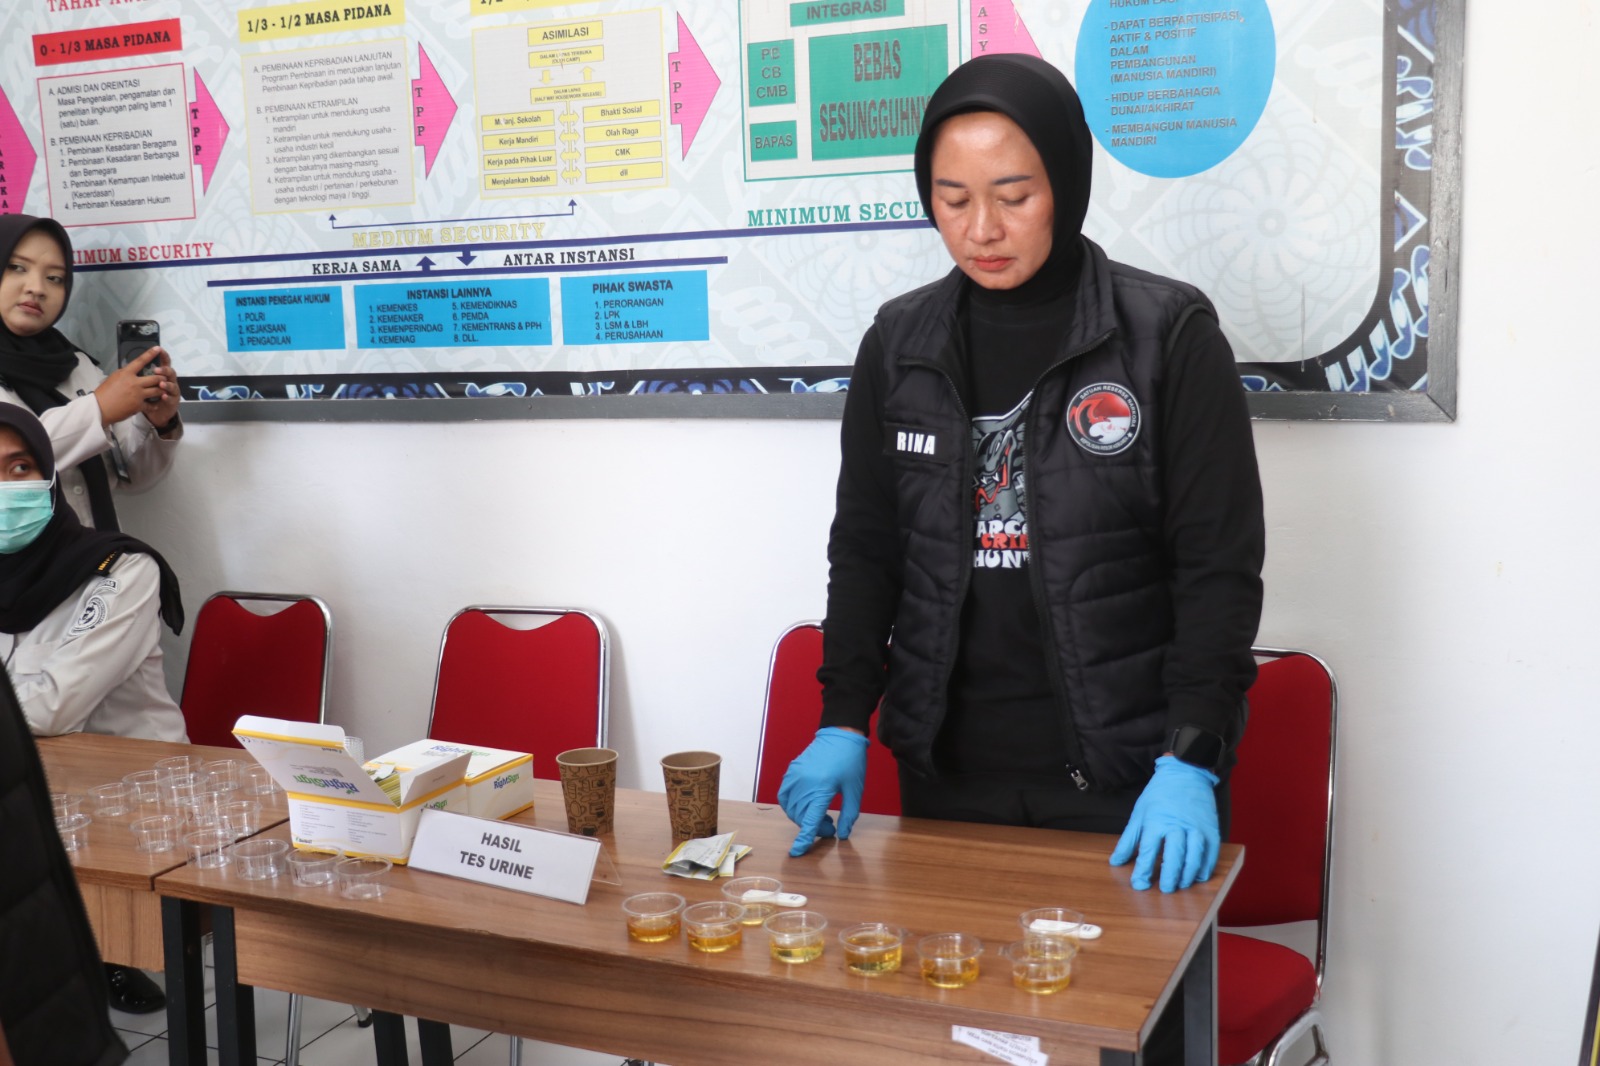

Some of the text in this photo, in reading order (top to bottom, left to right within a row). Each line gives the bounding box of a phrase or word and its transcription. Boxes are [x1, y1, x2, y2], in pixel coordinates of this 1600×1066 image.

[807, 0, 887, 20] INTEGRASI
[247, 4, 391, 33] 1/3 1/2 MASA PIDANA
[1111, 19, 1145, 31] DAPAT
[542, 27, 589, 41] ASIMILASI
[1110, 28, 1197, 44] AKTIF POSITIF
[60, 41, 81, 55] 1/3
[85, 37, 120, 51] MASA
[123, 31, 171, 46] PIDANA
[761, 48, 781, 61] PB
[1111, 45, 1149, 57] DALAM
[853, 40, 901, 83] BEBAS
[1111, 56, 1196, 70] PEMBANGUNAN
[762, 66, 781, 79] CB
[1110, 66, 1217, 84] (MANUSIA MANDIRI)
[57, 85, 81, 95] ADMISI
[83, 83, 99, 93] DAN
[756, 85, 788, 99] CMB
[1111, 86, 1221, 103] HIDUP BERBAHAGIA
[57, 87, 176, 106] Masa pengamatan dan
[59, 100, 167, 119] penelitian lingkungan paling lama
[600, 106, 642, 116] Bhakti Sosial
[517, 115, 541, 124] Sekolah
[819, 95, 931, 142] SESUNGGUHNY
[1111, 117, 1237, 134] MEMBANGUN MANUSIA
[59, 130, 153, 145] PEMBINAAN KEPRIBADIAN
[606, 128, 639, 137] Olah Raga
[67, 139, 177, 155] Pembinaan Kesadaran Beragama
[499, 136, 539, 146] Kerja Mandiri
[755, 135, 793, 150] BAPAS
[1111, 136, 1157, 147] MANDIRI
[68, 150, 180, 166] Pembinaan Kesadaran Berbangsa
[615, 148, 631, 156] CMK
[504, 157, 519, 165] pada
[69, 170, 81, 178] dan
[70, 171, 186, 188] Pembinaan Kemampuan Intelektual
[620, 169, 628, 177] dll
[491, 175, 550, 186] Menjalankan Ibadah
[72, 189, 115, 200] (Kecerdasan)
[72, 195, 171, 210] Pembinaan Kesadaran Hukum
[748, 201, 929, 227] MINIMUM SECU
[352, 222, 546, 248] MEDIUM SECURITY
[127, 242, 214, 262] SECURITY
[503, 248, 635, 266] ANTAR INSTANSI
[312, 259, 402, 274] KERJA SAMA
[592, 279, 673, 294] PIHAK SWASTA
[236, 293, 330, 307] INSTANSI PENEGAK HUKUM
[407, 287, 492, 300] INSTANSI LAINNYA
[376, 303, 418, 312] KEMENKES
[460, 300, 517, 310] KEMENDIKNAS
[603, 298, 664, 309] PERORANGAN
[245, 312, 265, 321] POLRI
[377, 314, 424, 323] KEMENAKER
[461, 312, 489, 320] PEMDA
[604, 310, 620, 319] LPK
[246, 324, 286, 334] KEJAKSAAN
[378, 324, 443, 334] KEMENPERINDAG
[462, 322, 542, 331] KEMENTRANS PPH
[604, 320, 649, 330] LSM LBH
[247, 336, 291, 346] PENGADILAN
[378, 335, 416, 344] KEMENAG
[462, 334, 479, 342] DLL.
[605, 330, 663, 341] PERUSAHAAN
[1080, 386, 1102, 400] SATUAN
[896, 431, 936, 455] RINA
[480, 832, 523, 853] HASIL
[459, 850, 534, 880] TES URINE
